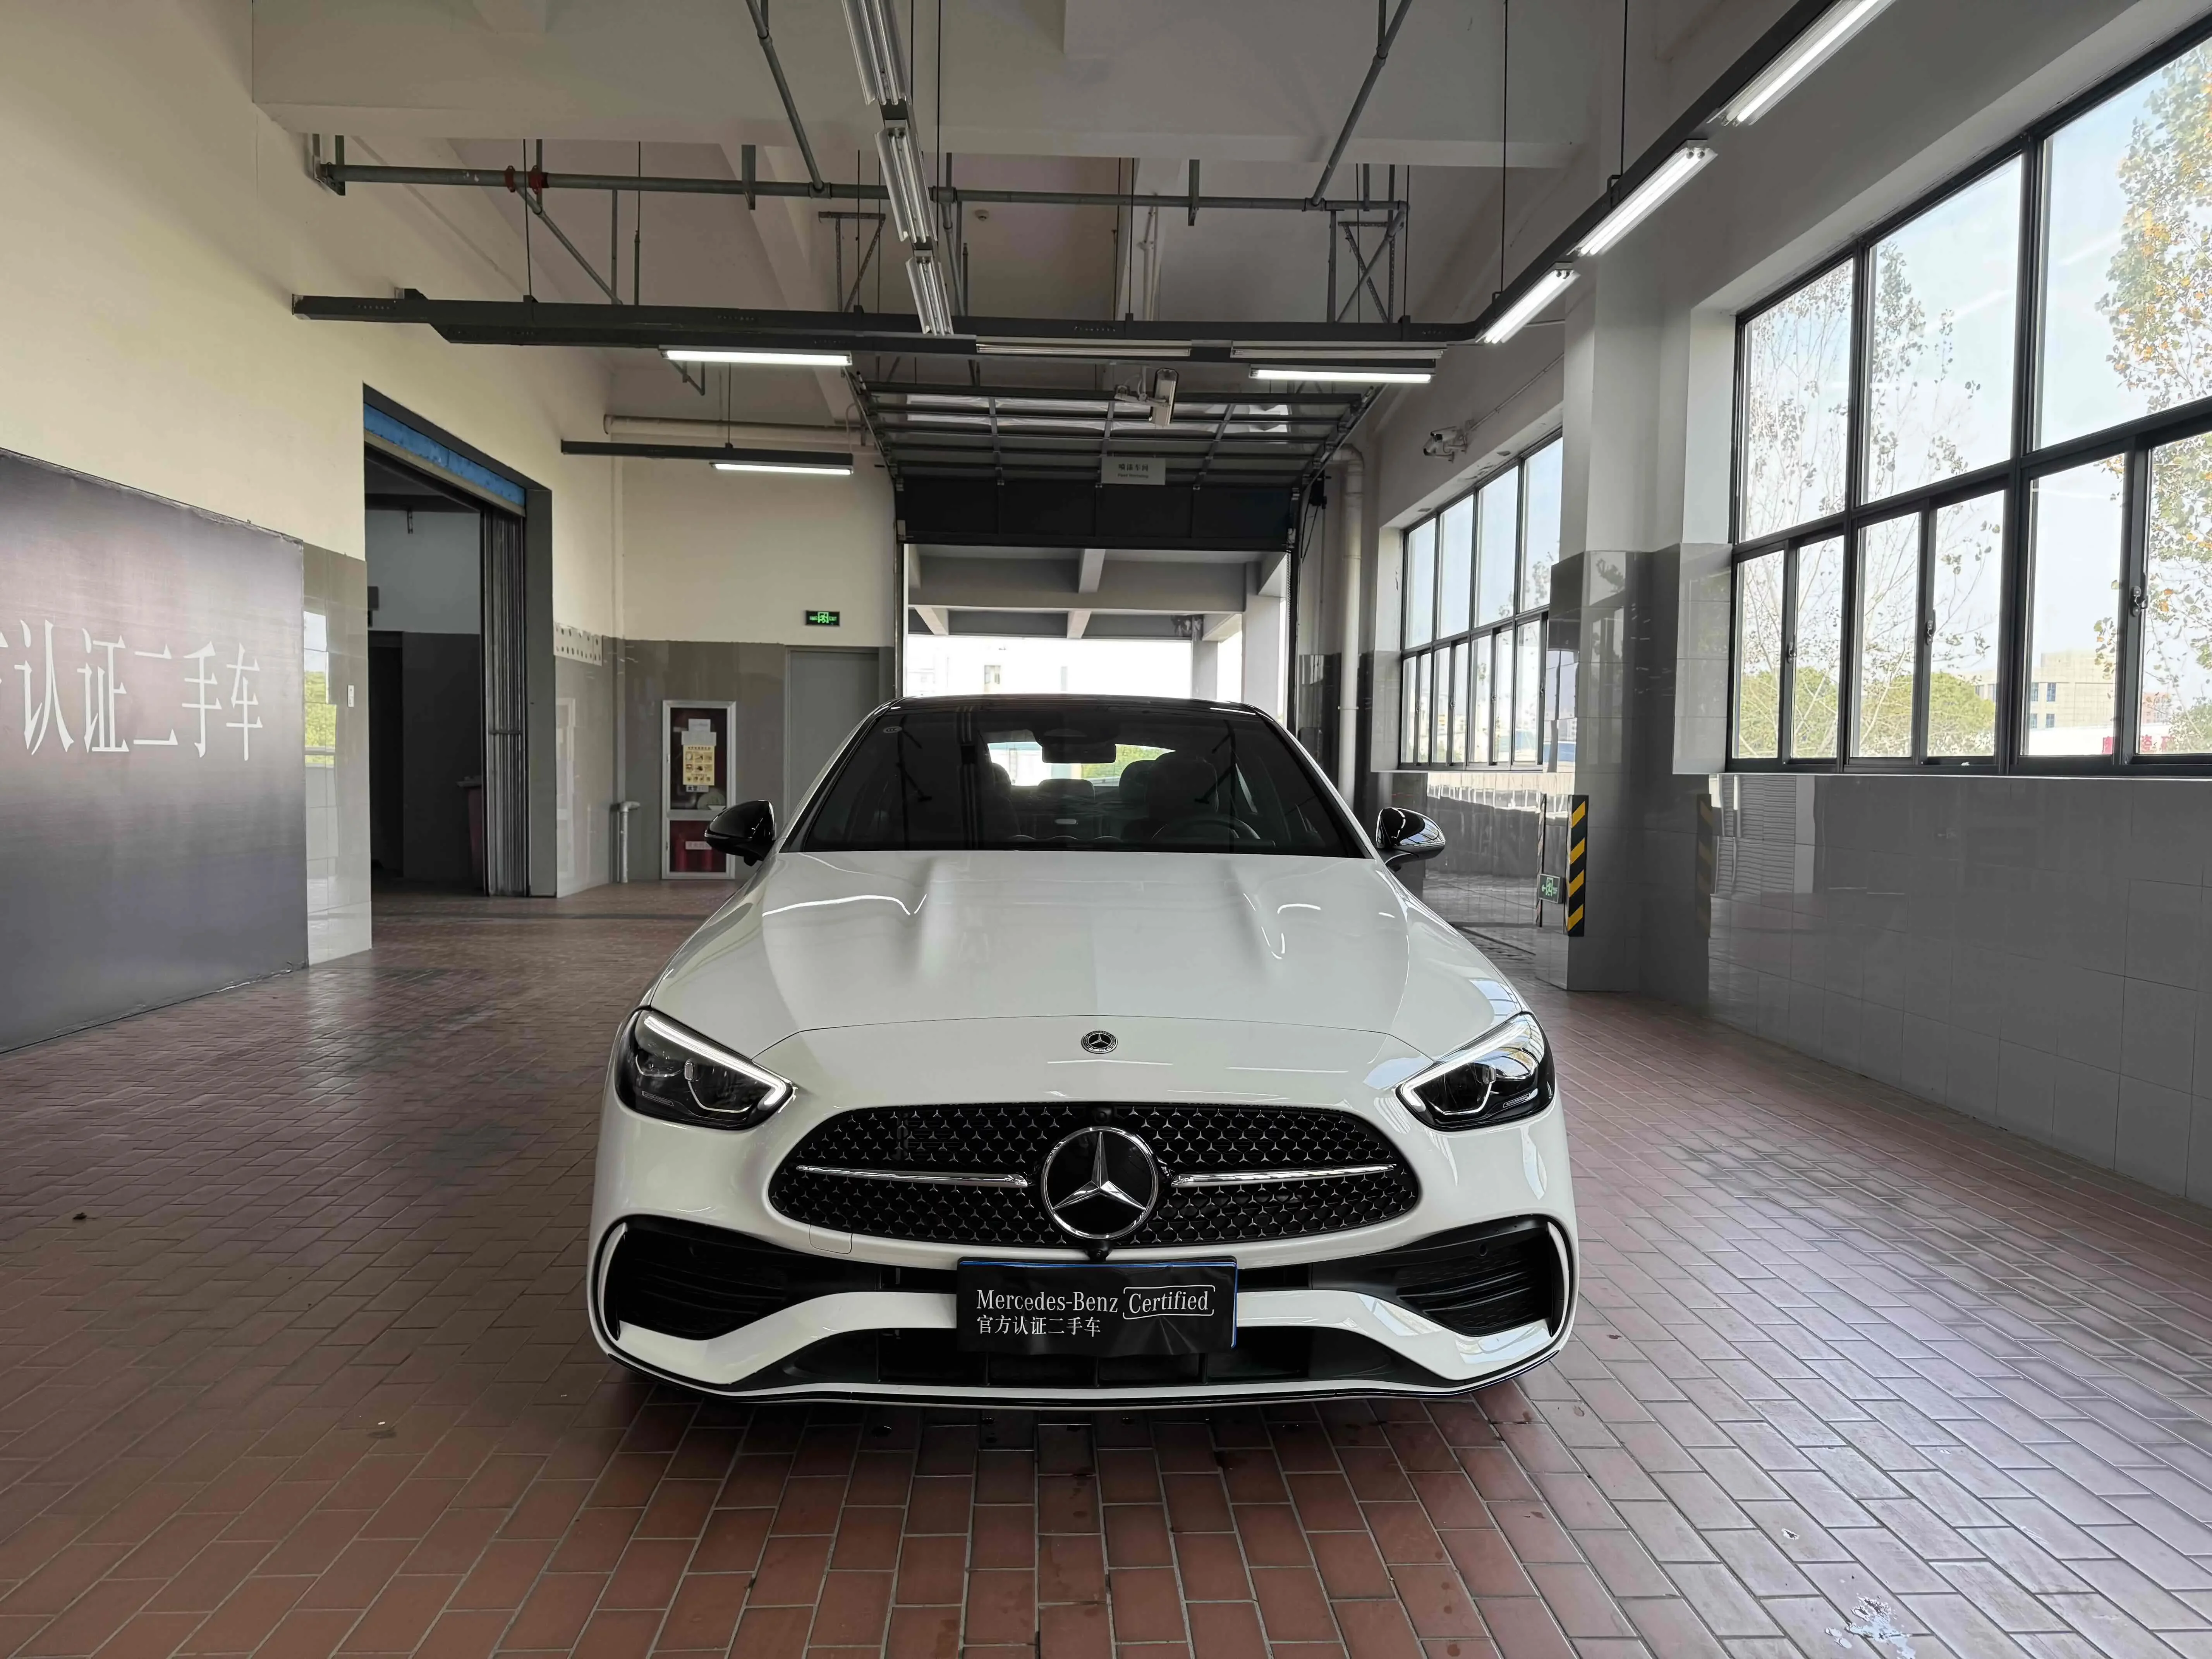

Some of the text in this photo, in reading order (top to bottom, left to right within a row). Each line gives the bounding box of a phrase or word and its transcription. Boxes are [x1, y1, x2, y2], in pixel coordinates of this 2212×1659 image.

[0, 619, 263, 761] 认证二手车
[976, 1290, 1209, 1314] Mercedes-Benz Certified
[977, 1316, 1101, 1337] 官方认证二手车
